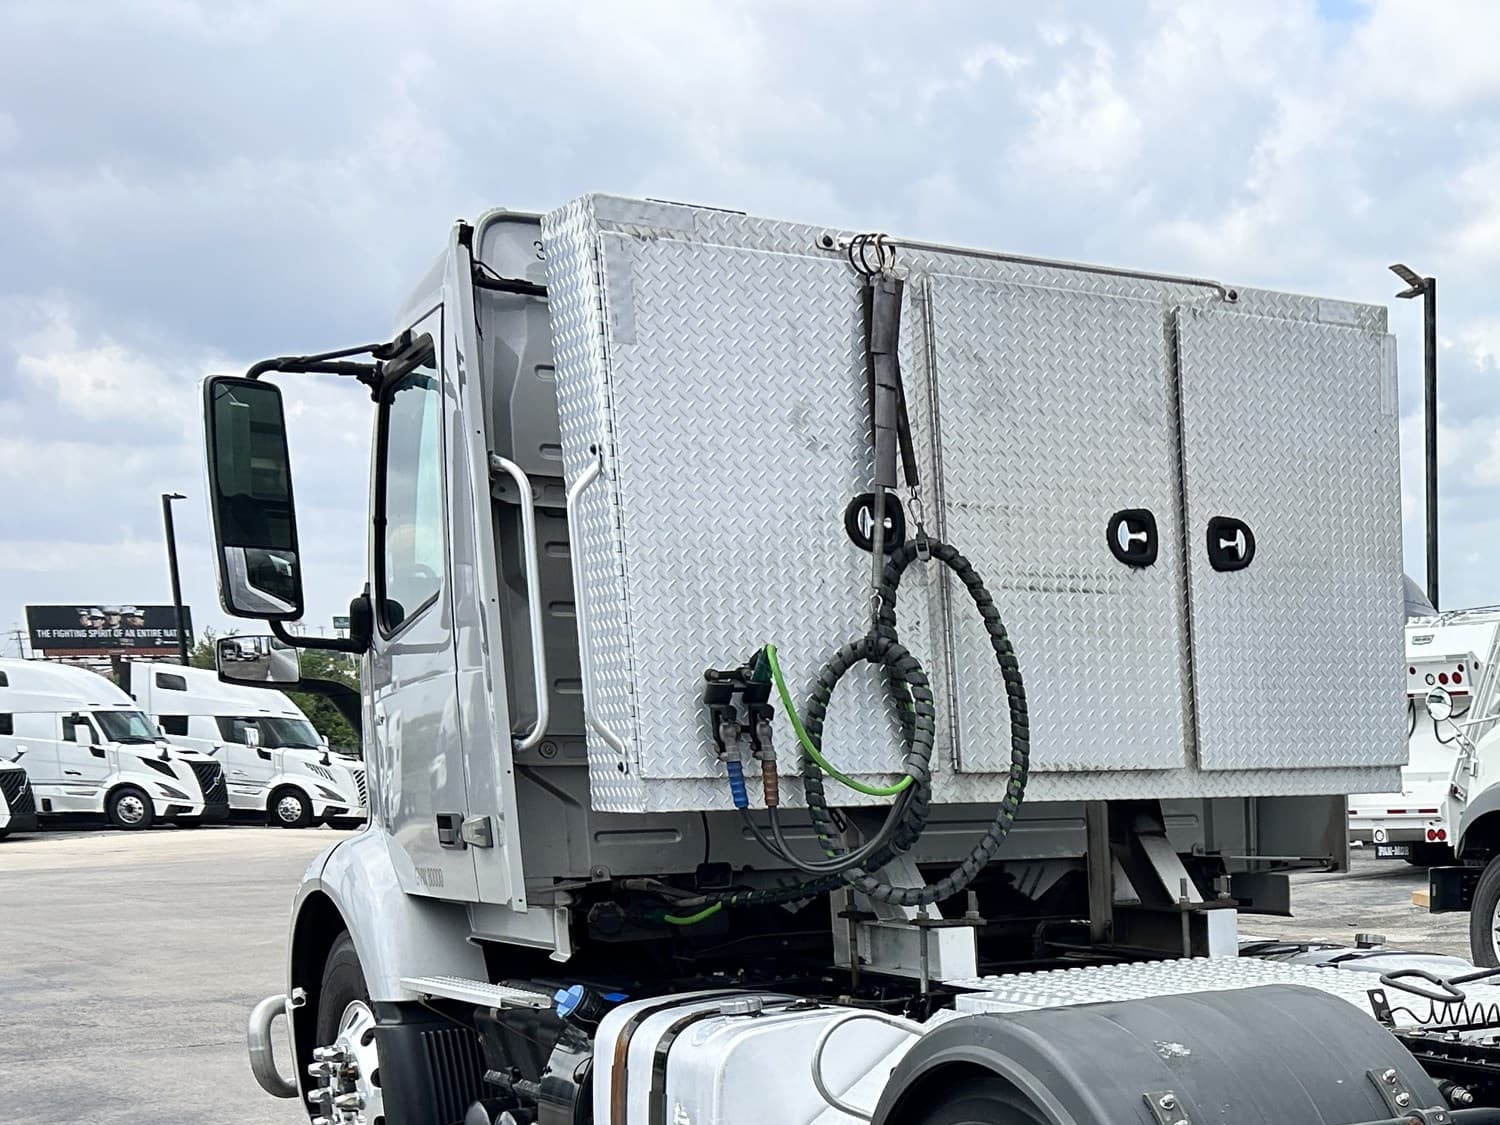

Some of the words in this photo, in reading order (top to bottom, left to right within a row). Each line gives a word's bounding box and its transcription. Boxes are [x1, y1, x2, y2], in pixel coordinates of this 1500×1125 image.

[36, 629, 51, 638] THE
[52, 629, 87, 638] FIGHTING
[88, 629, 112, 638] SPIRIT
[113, 629, 124, 638] OF
[125, 629, 136, 638] AN
[137, 629, 162, 638] ENTIRE
[163, 629, 190, 638] NATN
